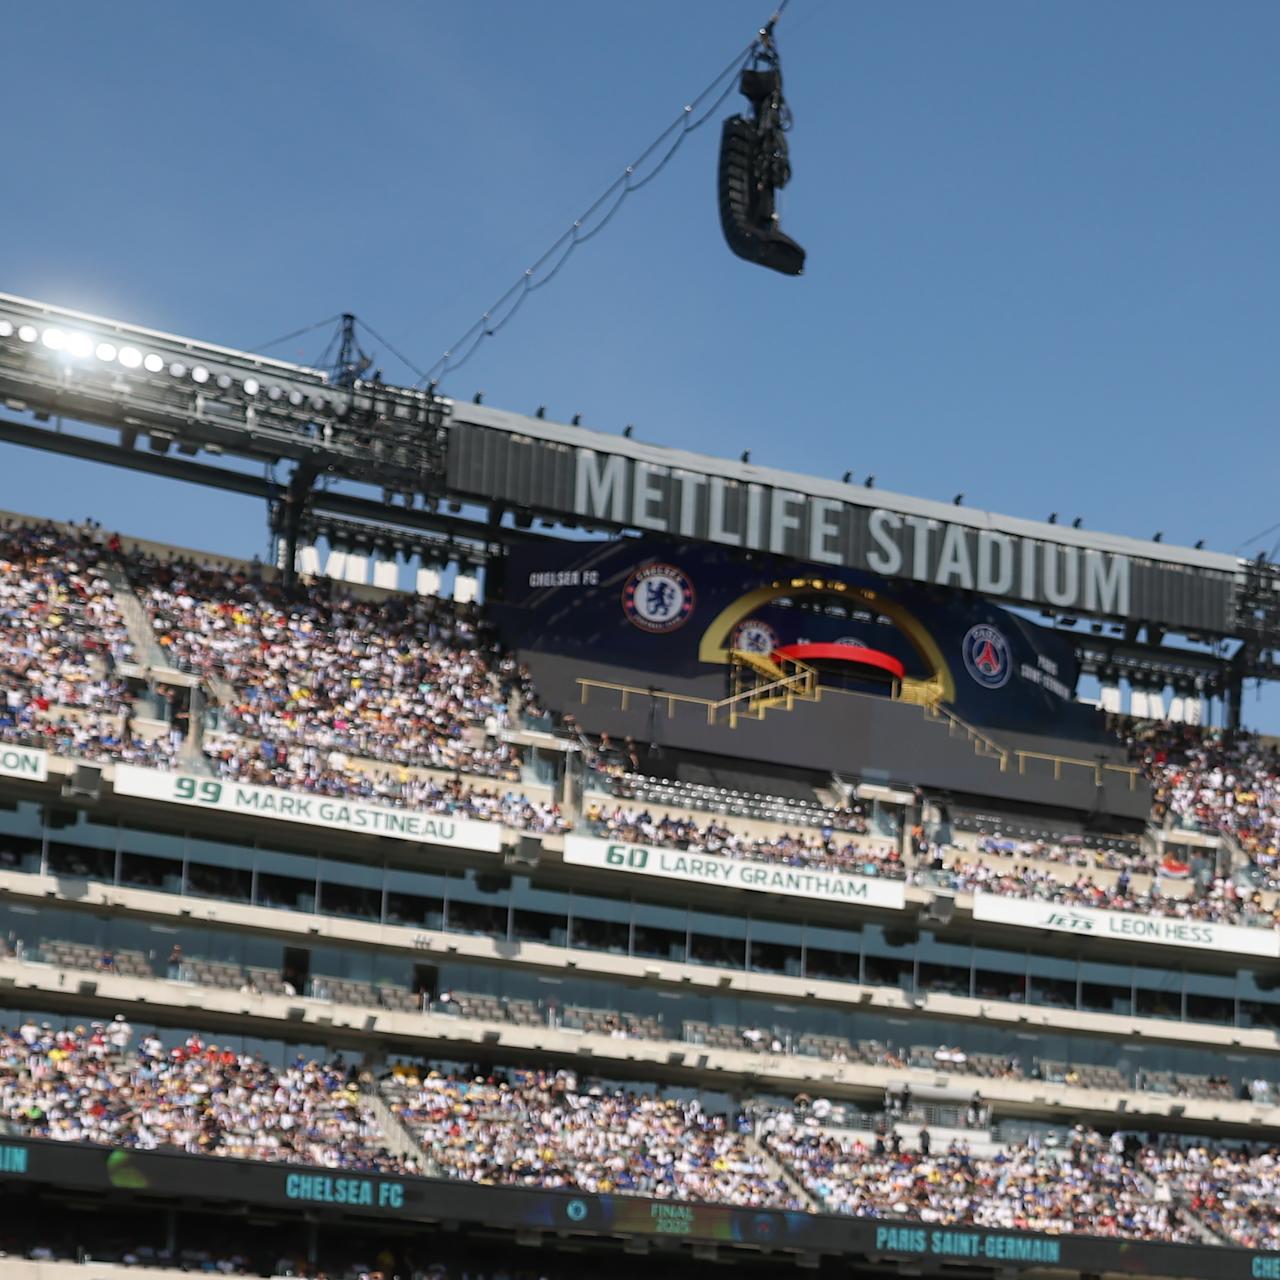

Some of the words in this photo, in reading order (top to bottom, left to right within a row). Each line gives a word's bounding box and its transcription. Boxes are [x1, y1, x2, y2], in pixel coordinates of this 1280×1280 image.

[573, 446, 845, 566] METLIFE
[865, 508, 1131, 617] STADIUM
[529, 570, 580, 588] CHELSEA
[582, 570, 600, 586] FC
[173, 776, 223, 804] 99
[235, 788, 312, 818] MARK
[318, 802, 457, 840] GASTINEAU
[604, 845, 648, 869] 60
[659, 853, 735, 880] LARRY
[740, 866, 869, 899] GRANTHAM
[1046, 912, 1095, 930] JETS
[1109, 917, 1160, 937] LEON
[1164, 925, 1213, 943] HESS
[286, 1173, 373, 1206] CHELSEA
[378, 1182, 404, 1208] FC
[651, 1203, 694, 1222] FINAL
[876, 1227, 926, 1255] PARIS
[931, 1232, 1060, 1264] SAINT-GERMAIN
